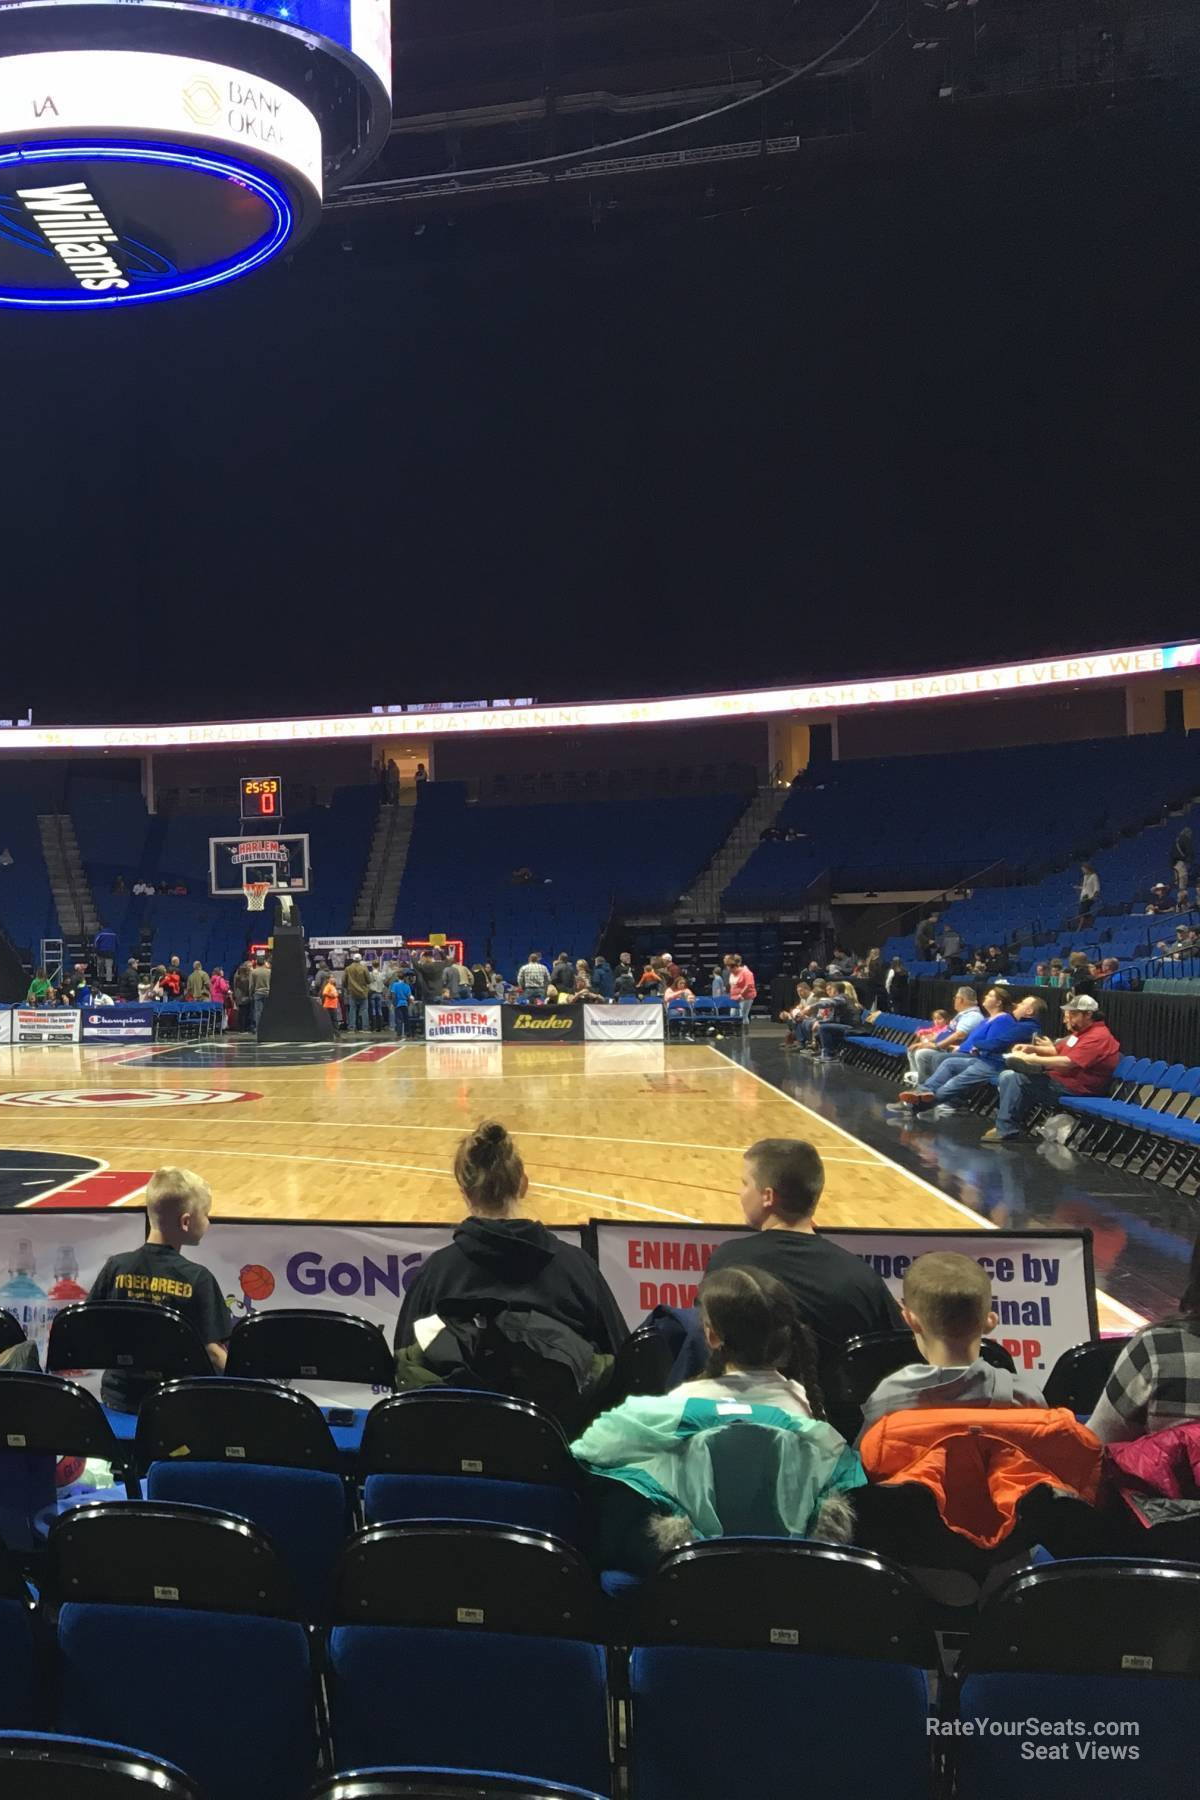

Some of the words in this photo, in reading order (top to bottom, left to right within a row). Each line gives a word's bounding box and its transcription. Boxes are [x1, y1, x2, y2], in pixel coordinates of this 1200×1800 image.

[16, 182, 130, 290] Williams
[894, 671, 1005, 699] BRADLEY
[1016, 660, 1097, 685] EVERY
[188, 726, 281, 743] BRADLEY
[291, 721, 357, 738] EVERY
[368, 716, 471, 734] WEEKDAY
[482, 709, 588, 728] MORNING
[245, 781, 278, 794] 25:53
[261, 793, 274, 814] 0
[238, 841, 280, 856] HARLEM
[231, 852, 288, 864] GLOBETROTTERS
[89, 1015, 147, 1028] Champion
[437, 1012, 488, 1025] HARLEM
[513, 1014, 574, 1029] Baden
[429, 1025, 498, 1037] GLOBETROTTERS
[1022, 1252, 1060, 1286] by
[114, 1273, 150, 1290] TIGER
[150, 1276, 193, 1298] BREED
